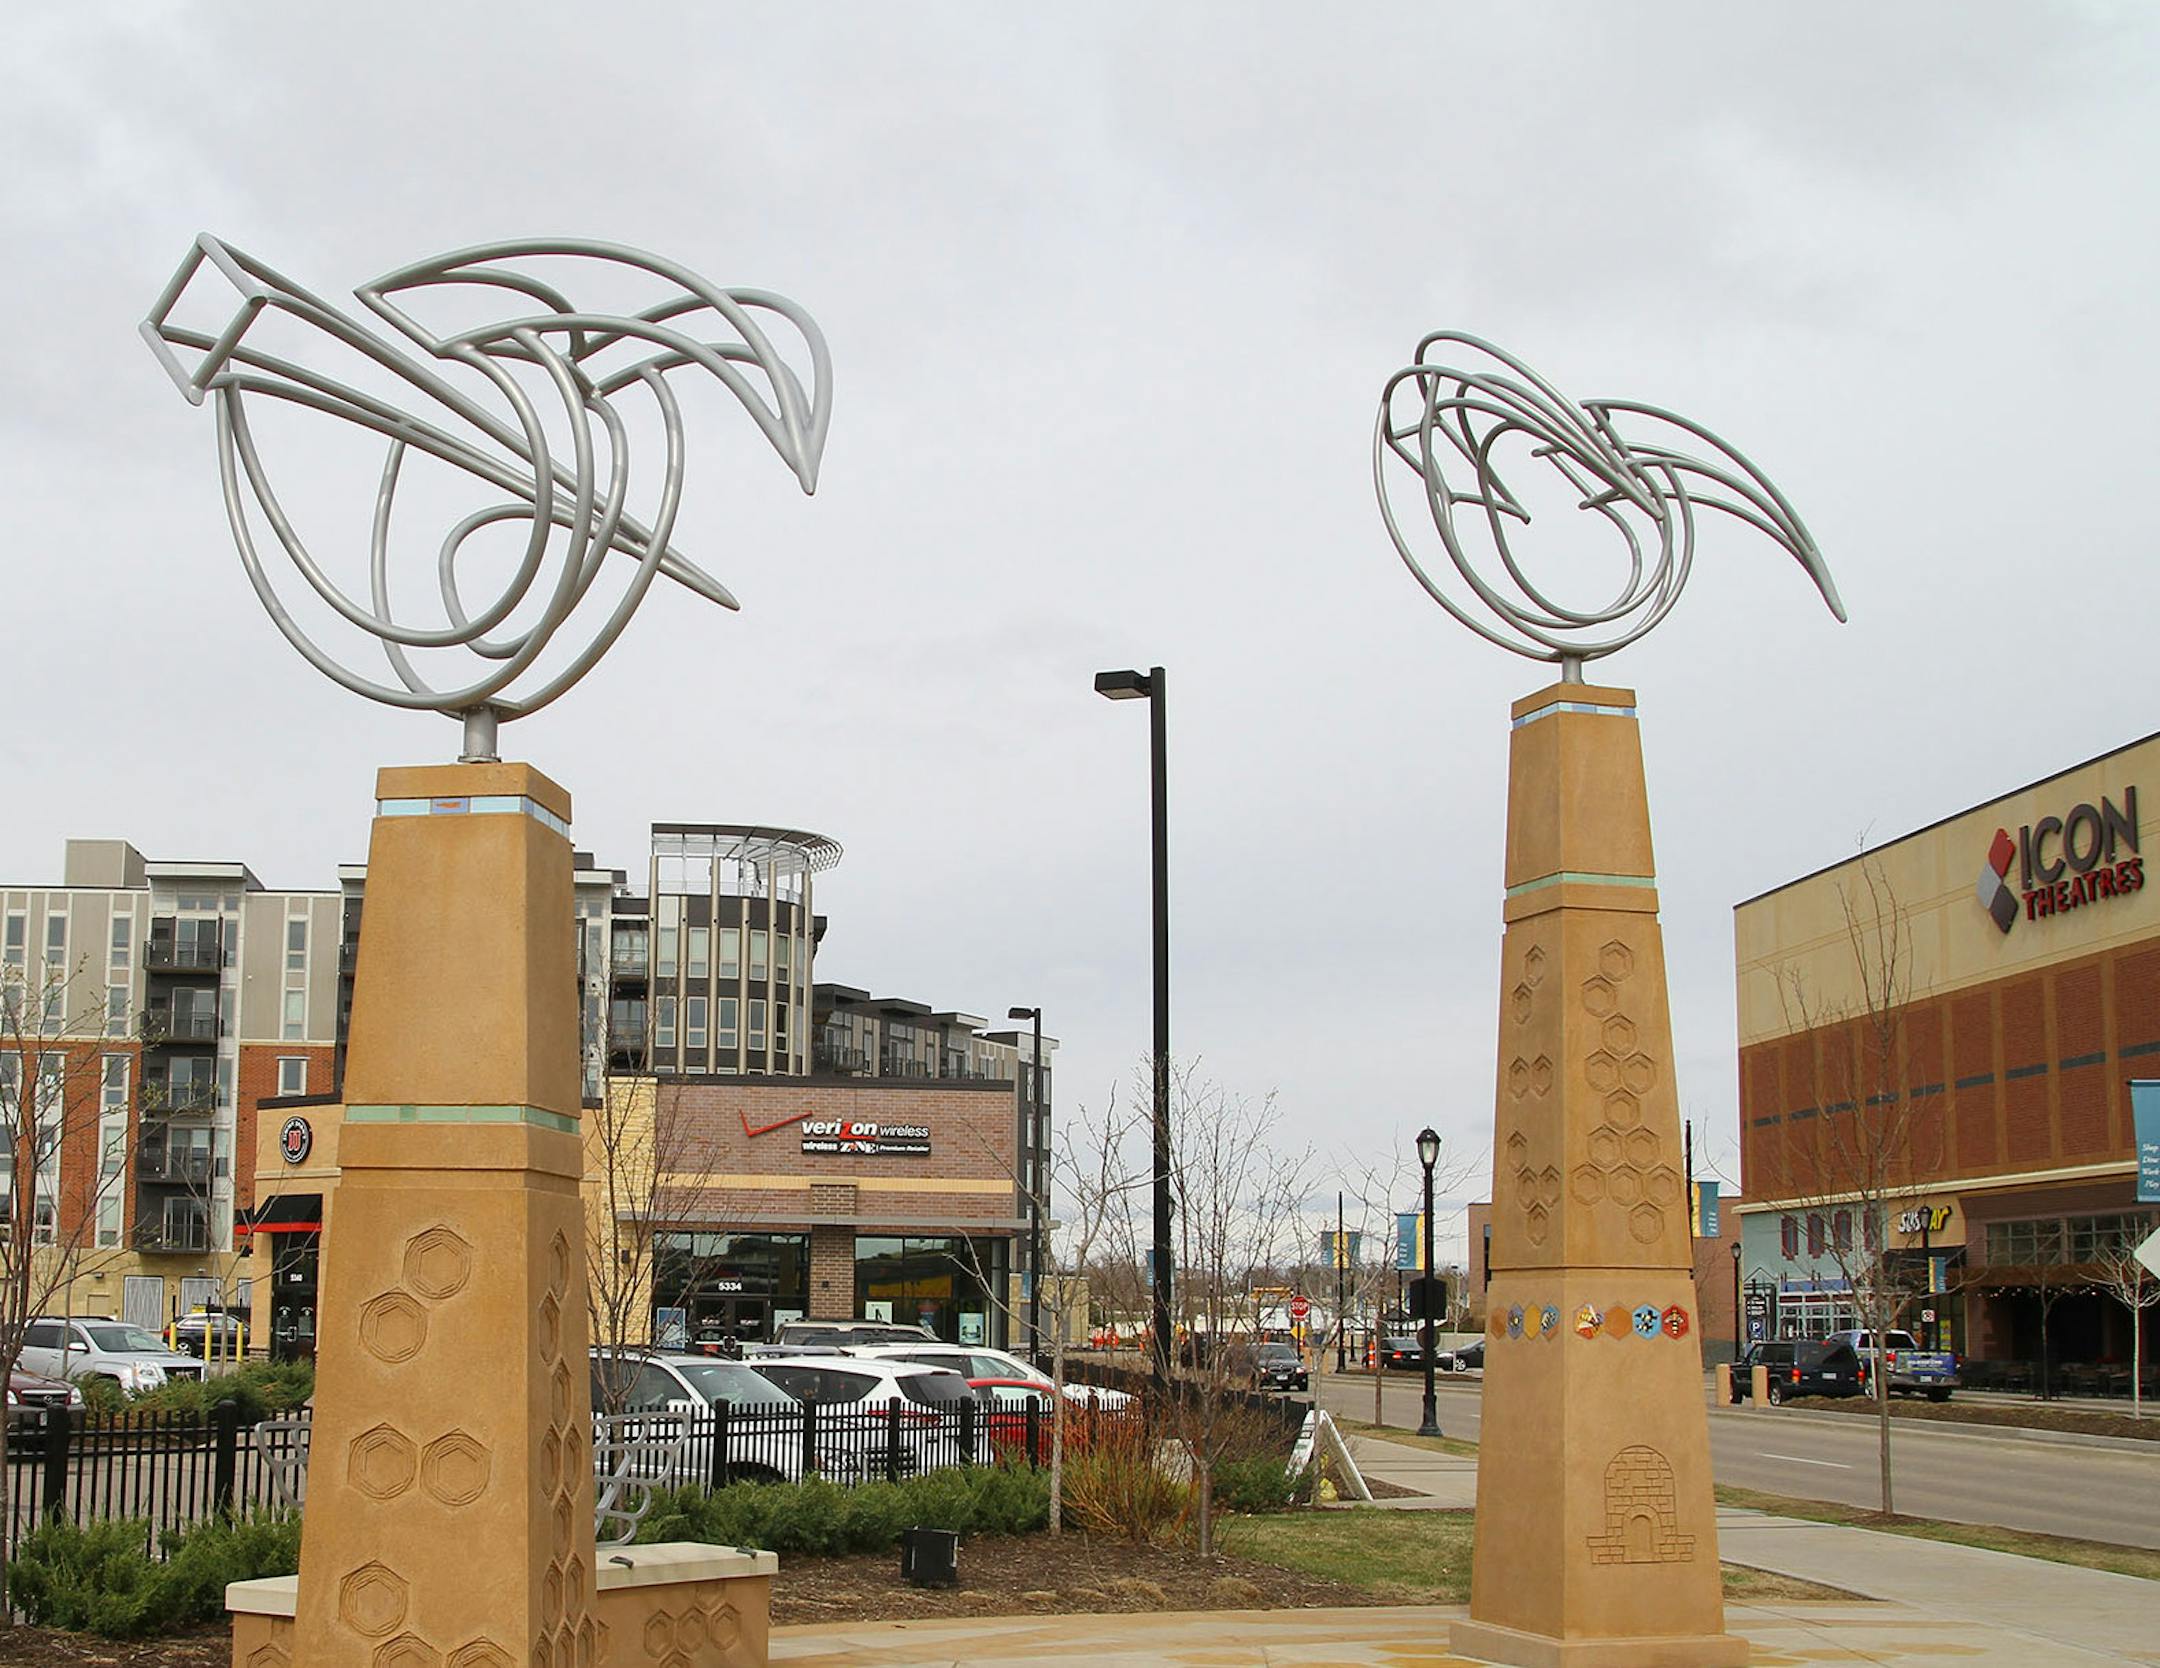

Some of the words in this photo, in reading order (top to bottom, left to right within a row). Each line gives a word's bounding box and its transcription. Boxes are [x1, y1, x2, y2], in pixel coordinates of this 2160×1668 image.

[2019, 785, 2139, 890] ICON
[2022, 857, 2144, 921] THEATRES
[801, 1118, 878, 1140] verizon
[880, 1125, 929, 1137] wireless
[802, 1141, 838, 1151] wireless
[1898, 1206, 1949, 1232] SUBAY
[718, 1282, 742, 1291] 5334
[1291, 1301, 1309, 1311] STOP
[1752, 1322, 1760, 1332] P
